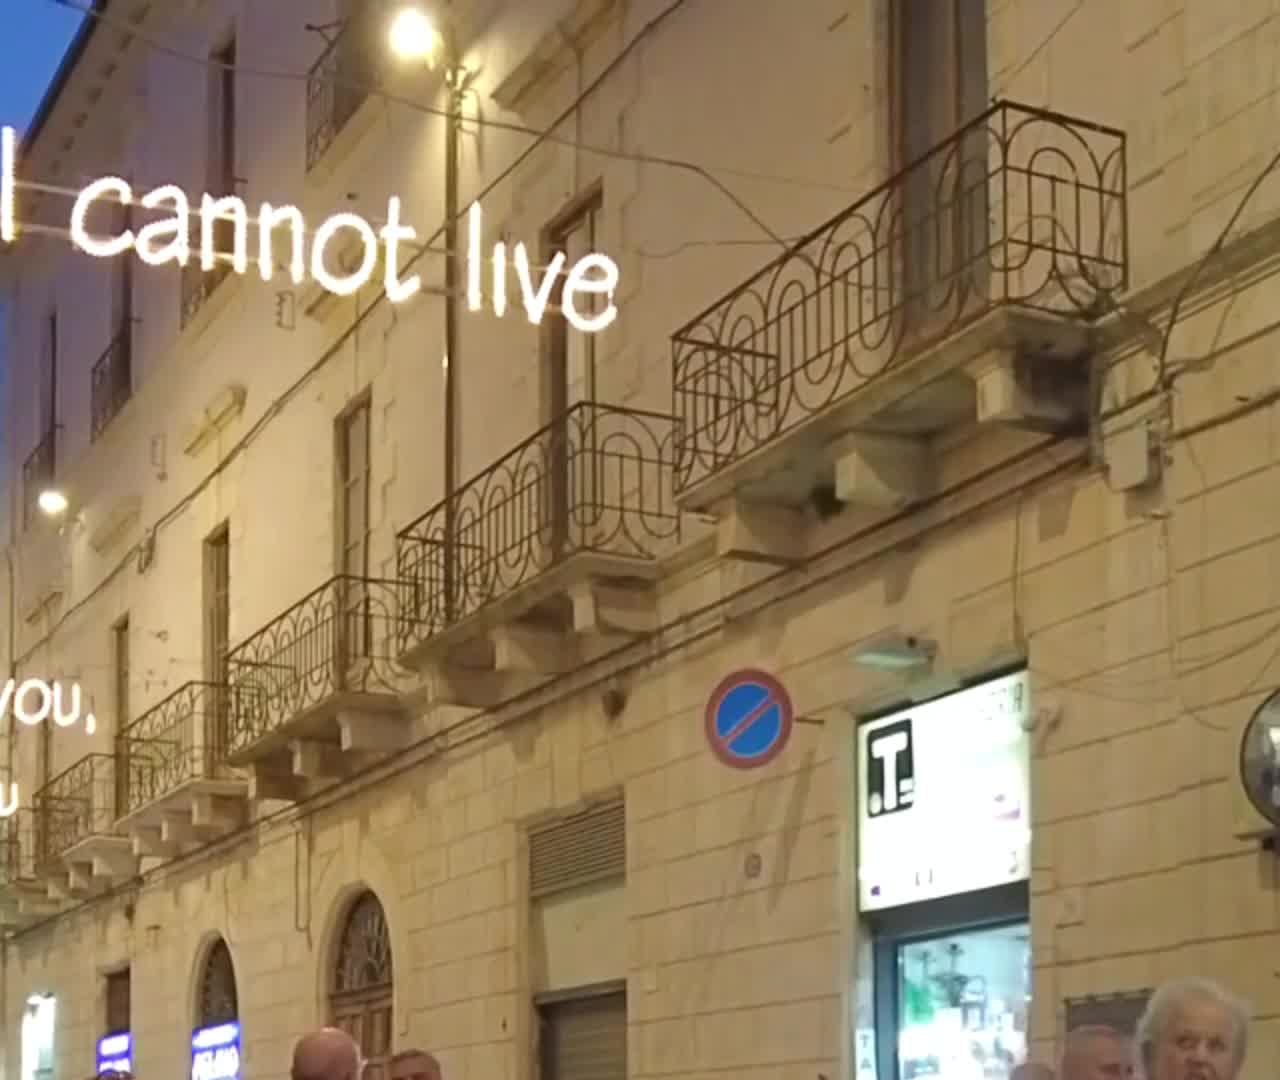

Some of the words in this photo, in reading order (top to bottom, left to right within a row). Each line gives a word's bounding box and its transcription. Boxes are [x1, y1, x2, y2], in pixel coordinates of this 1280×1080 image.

[0, 125, 17, 243] I
[70, 176, 421, 302] cannot
[466, 200, 619, 332] live
[872, 732, 907, 811] T
